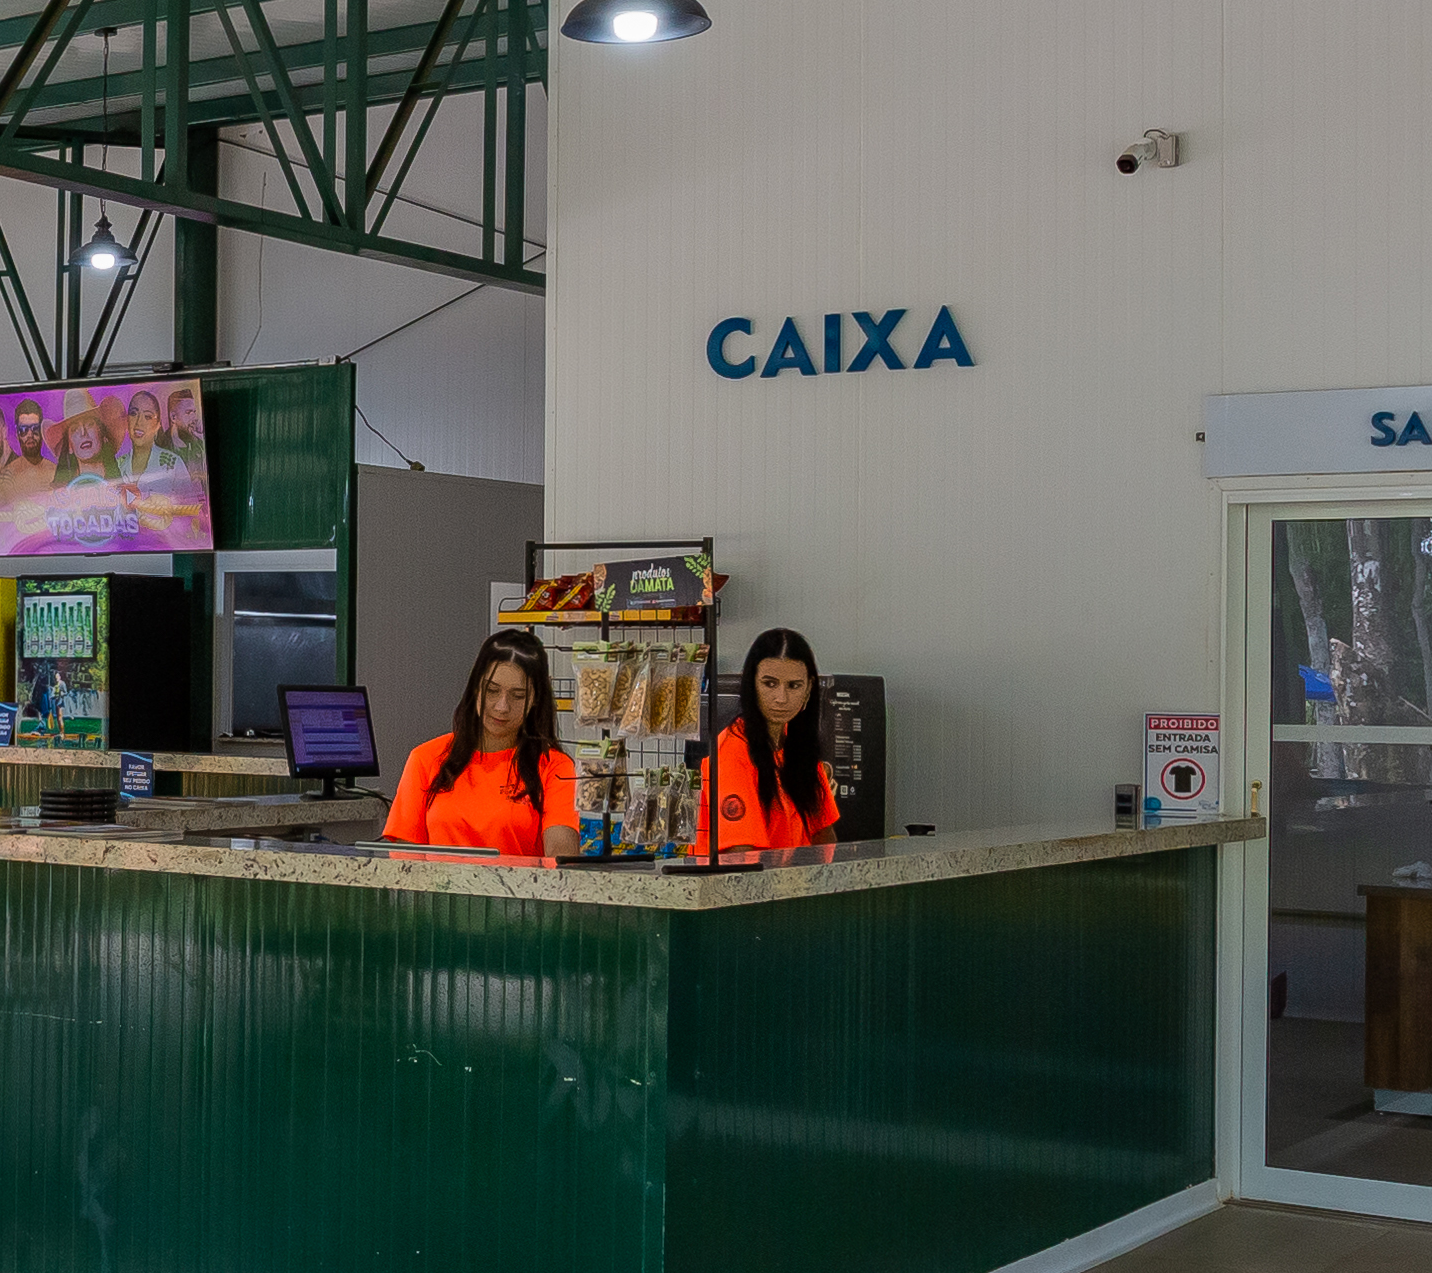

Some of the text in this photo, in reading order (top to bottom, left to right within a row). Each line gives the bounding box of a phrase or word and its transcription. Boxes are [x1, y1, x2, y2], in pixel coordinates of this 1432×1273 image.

[706, 304, 976, 380] CAIXA
[47, 513, 139, 536] TOCADAS
[1150, 718, 1217, 729] PROIBIDO
[1155, 733, 1212, 743] ENTRADA
[1148, 744, 1219, 754] SEM CAMISA
